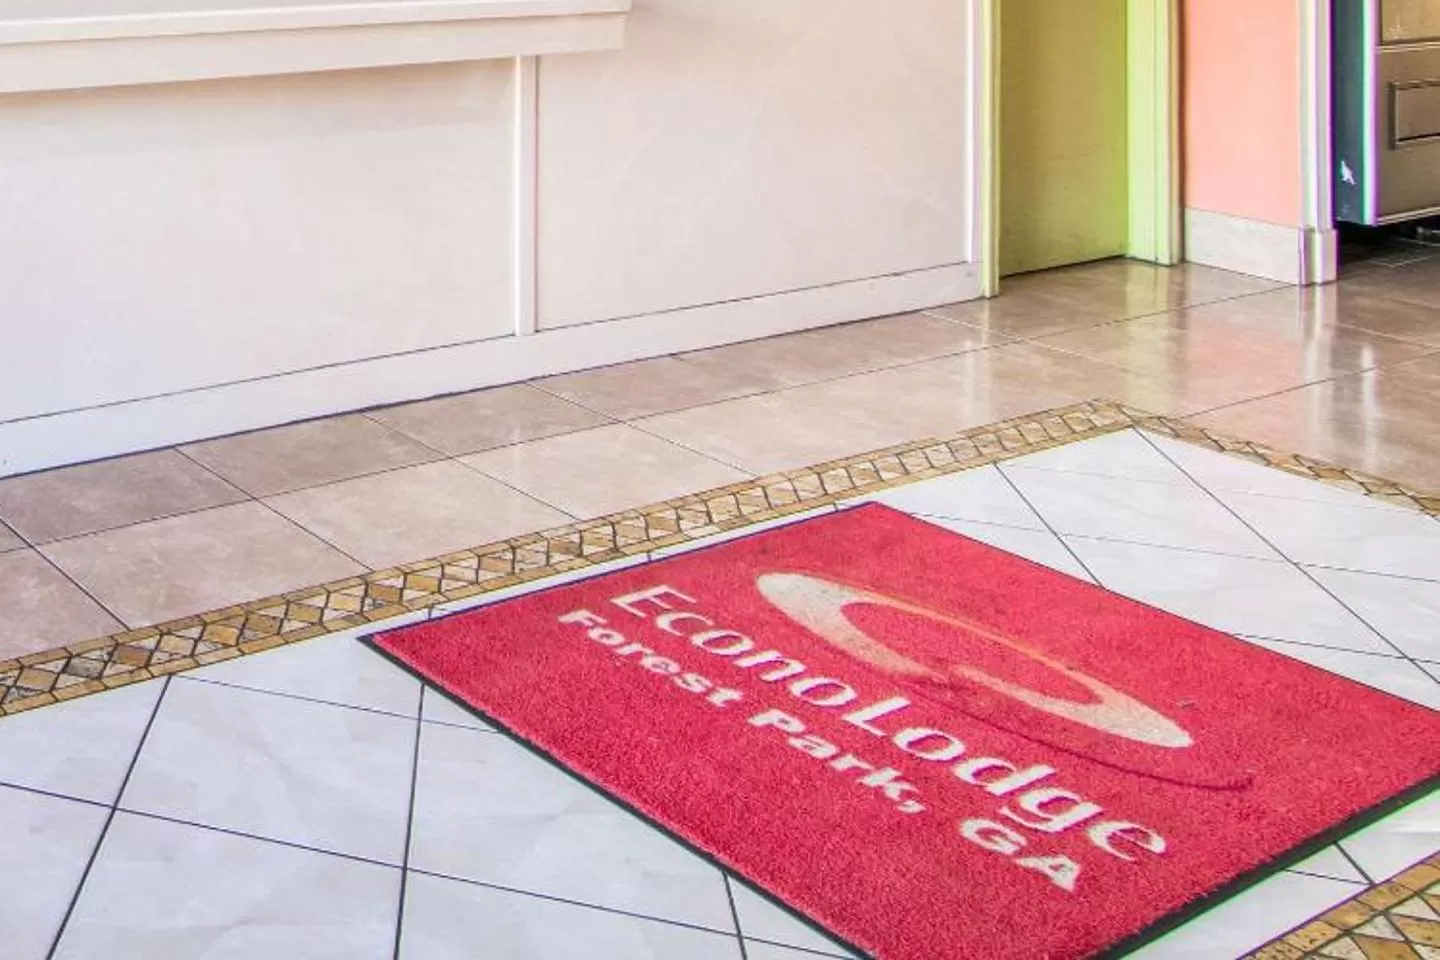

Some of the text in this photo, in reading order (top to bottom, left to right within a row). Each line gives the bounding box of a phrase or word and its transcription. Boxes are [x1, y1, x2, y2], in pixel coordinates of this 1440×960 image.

[558, 608, 1081, 892] Forest Park, GA
